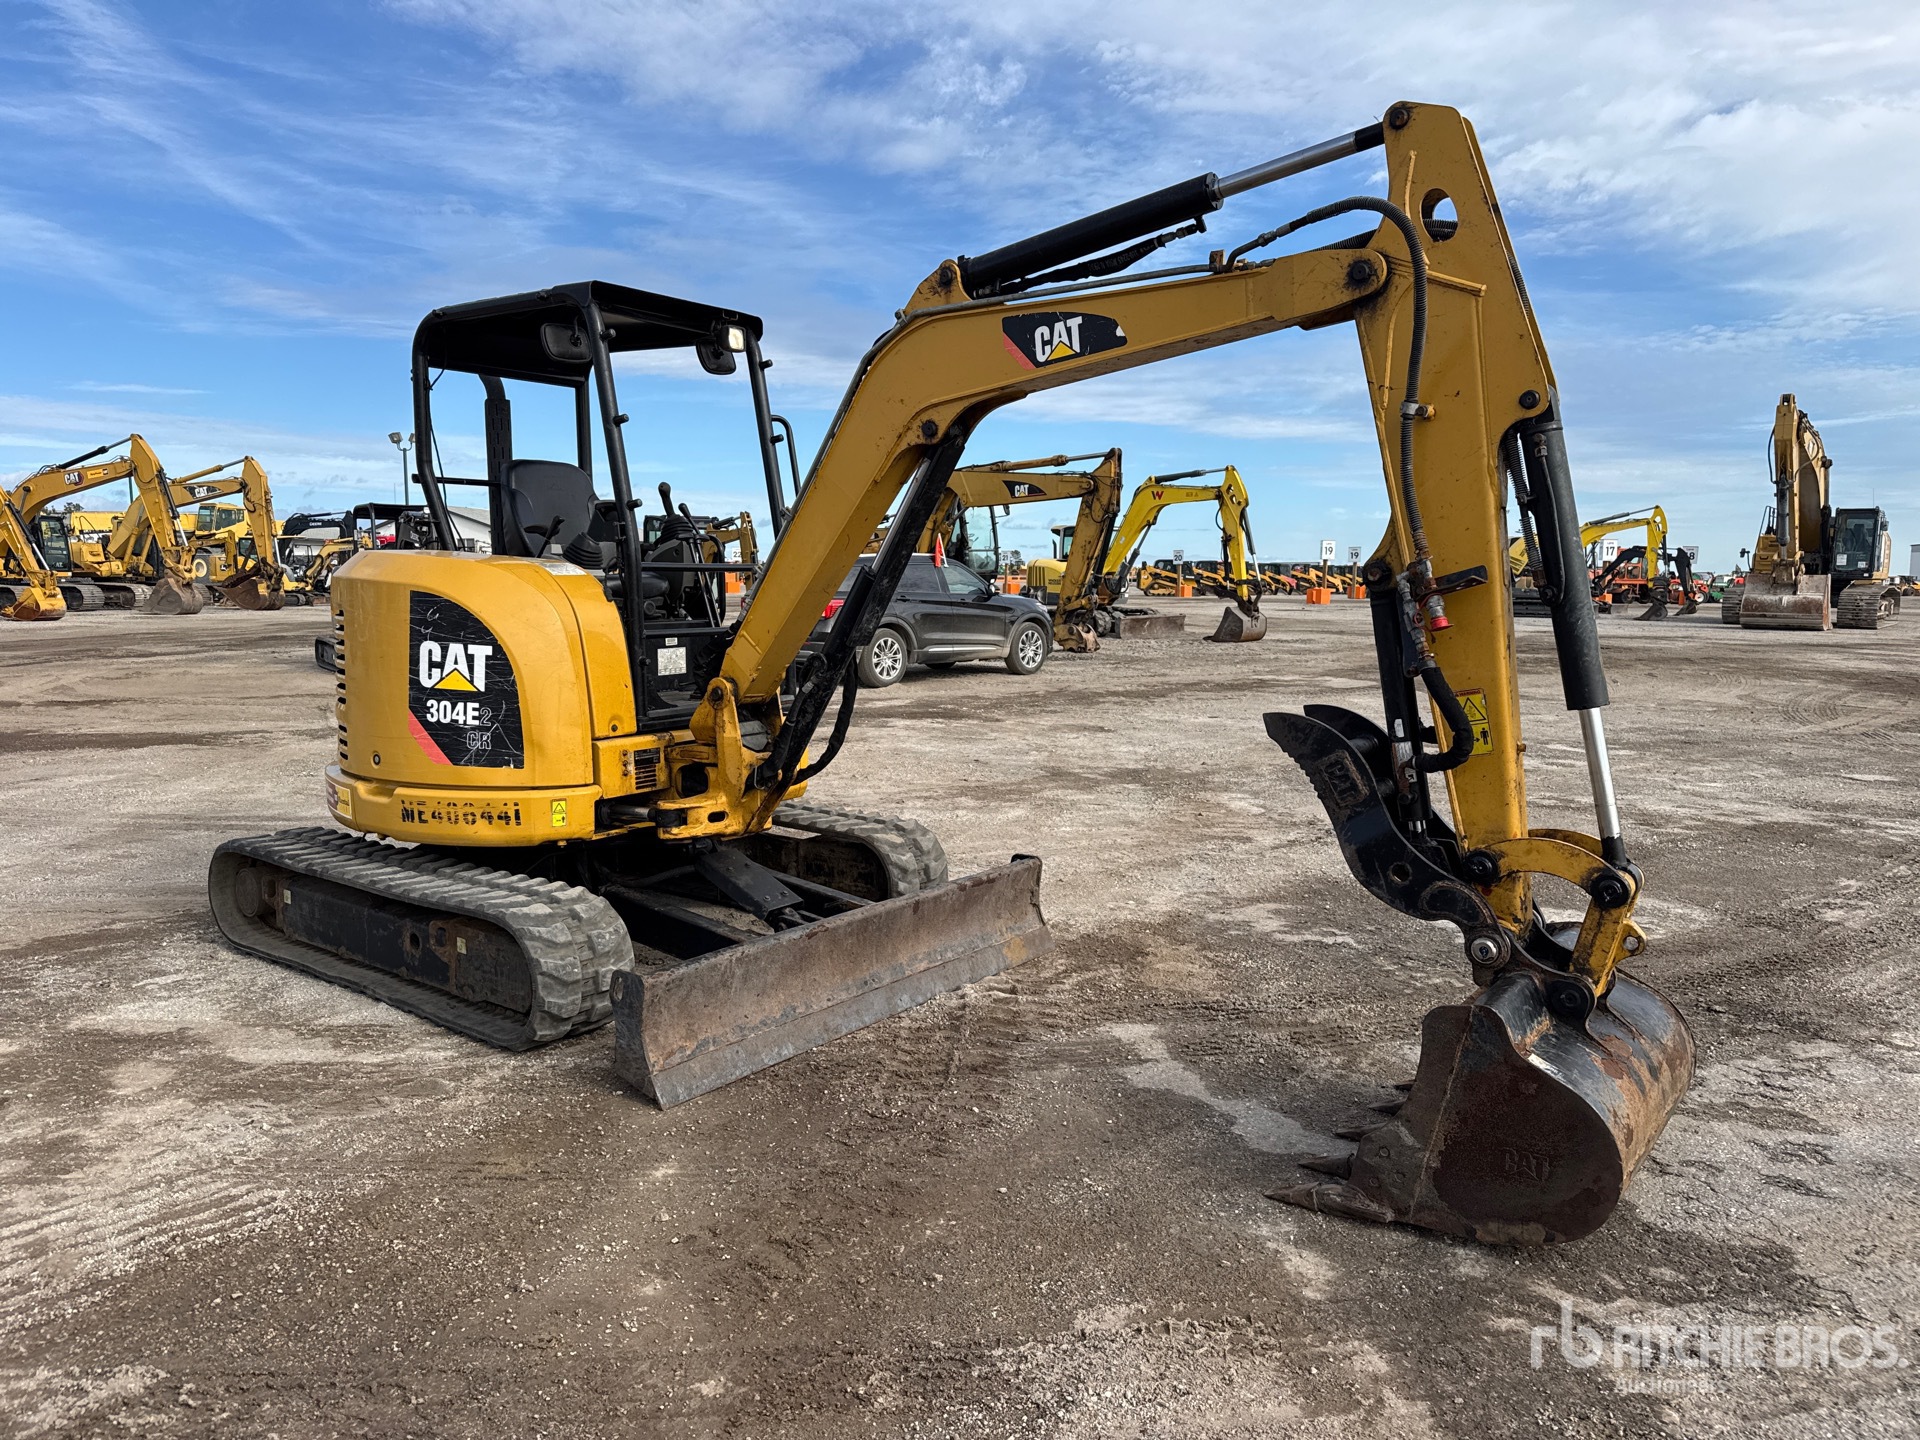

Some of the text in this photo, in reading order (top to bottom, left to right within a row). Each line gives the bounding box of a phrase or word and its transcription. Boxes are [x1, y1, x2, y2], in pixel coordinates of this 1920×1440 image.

[1034, 316, 1083, 363] CAT
[64, 472, 80, 485] CAT
[194, 486, 208, 498] CAT
[1014, 484, 1030, 498] CAT
[1324, 546, 1334, 556] 19
[1350, 551, 1359, 560] 19
[1605, 546, 1616, 556] 17
[1173, 554, 1183, 562] 20
[419, 640, 493, 692] CAT
[426, 699, 492, 727] 304E2
[466, 731, 492, 751] CR
